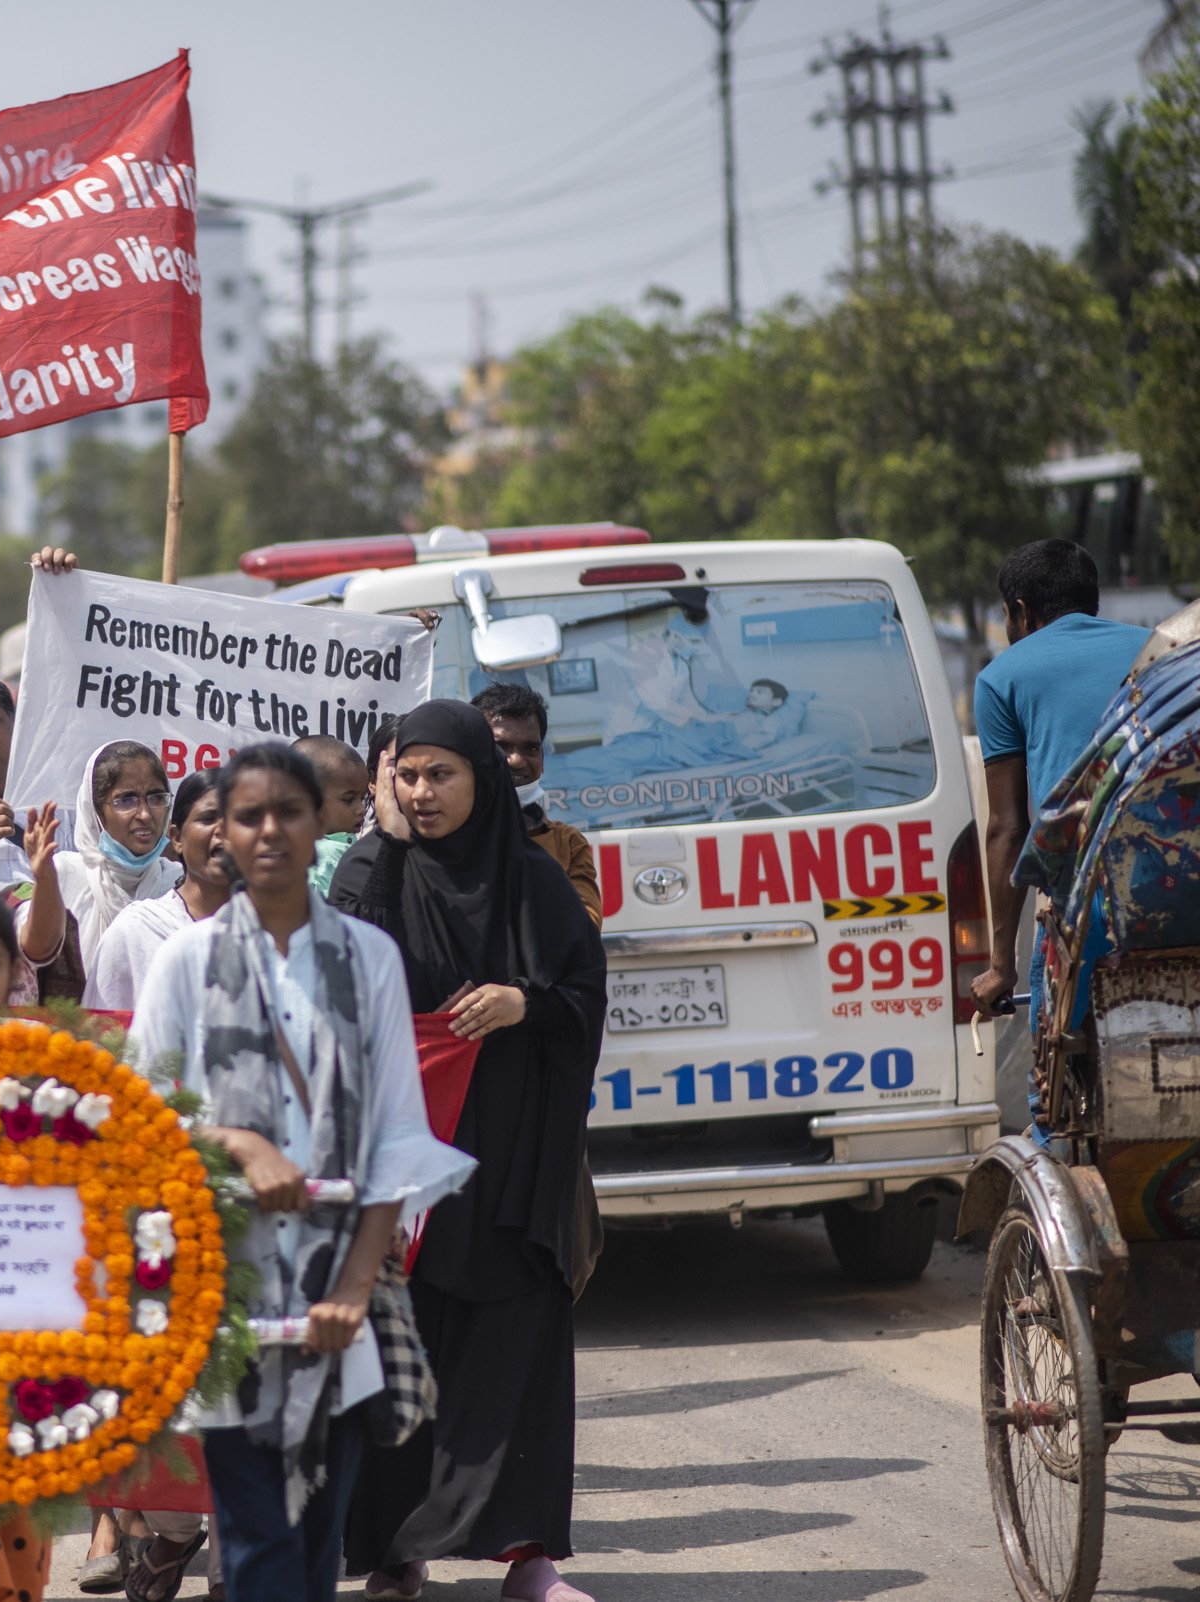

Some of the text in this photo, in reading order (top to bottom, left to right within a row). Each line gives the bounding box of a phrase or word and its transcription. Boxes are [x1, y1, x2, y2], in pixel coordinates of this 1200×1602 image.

[84, 603, 402, 682] Remember the Dead
[76, 664, 181, 717] Fight
[194, 679, 243, 727] for
[248, 688, 309, 737] the
[580, 772, 790, 810] CONDITION
[827, 935, 945, 994] 999
[831, 1000, 863, 1018] এর
[590, 1047, 914, 1111] 1-111820
